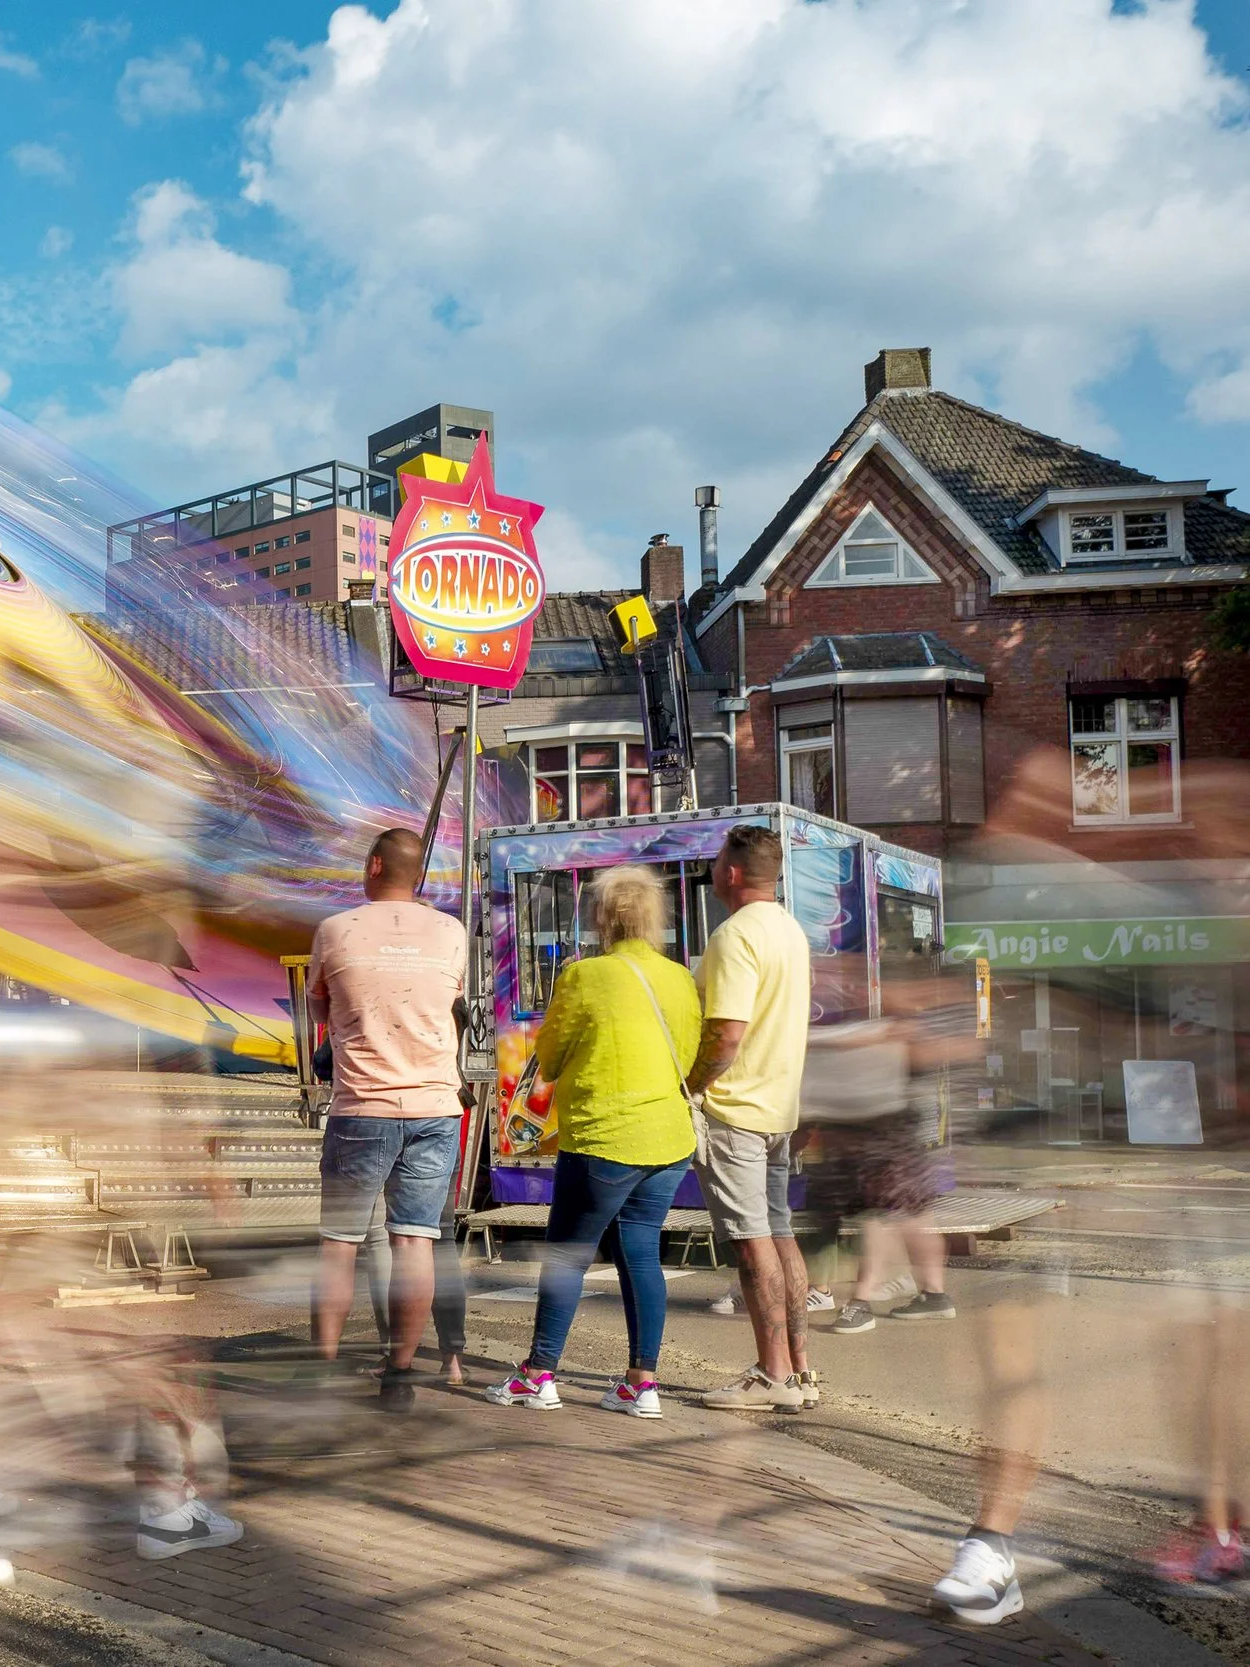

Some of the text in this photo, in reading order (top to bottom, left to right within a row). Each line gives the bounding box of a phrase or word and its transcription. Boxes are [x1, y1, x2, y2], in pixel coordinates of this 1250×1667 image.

[395, 549, 539, 616] TORNADO
[943, 924, 1210, 964] Angie Nails
